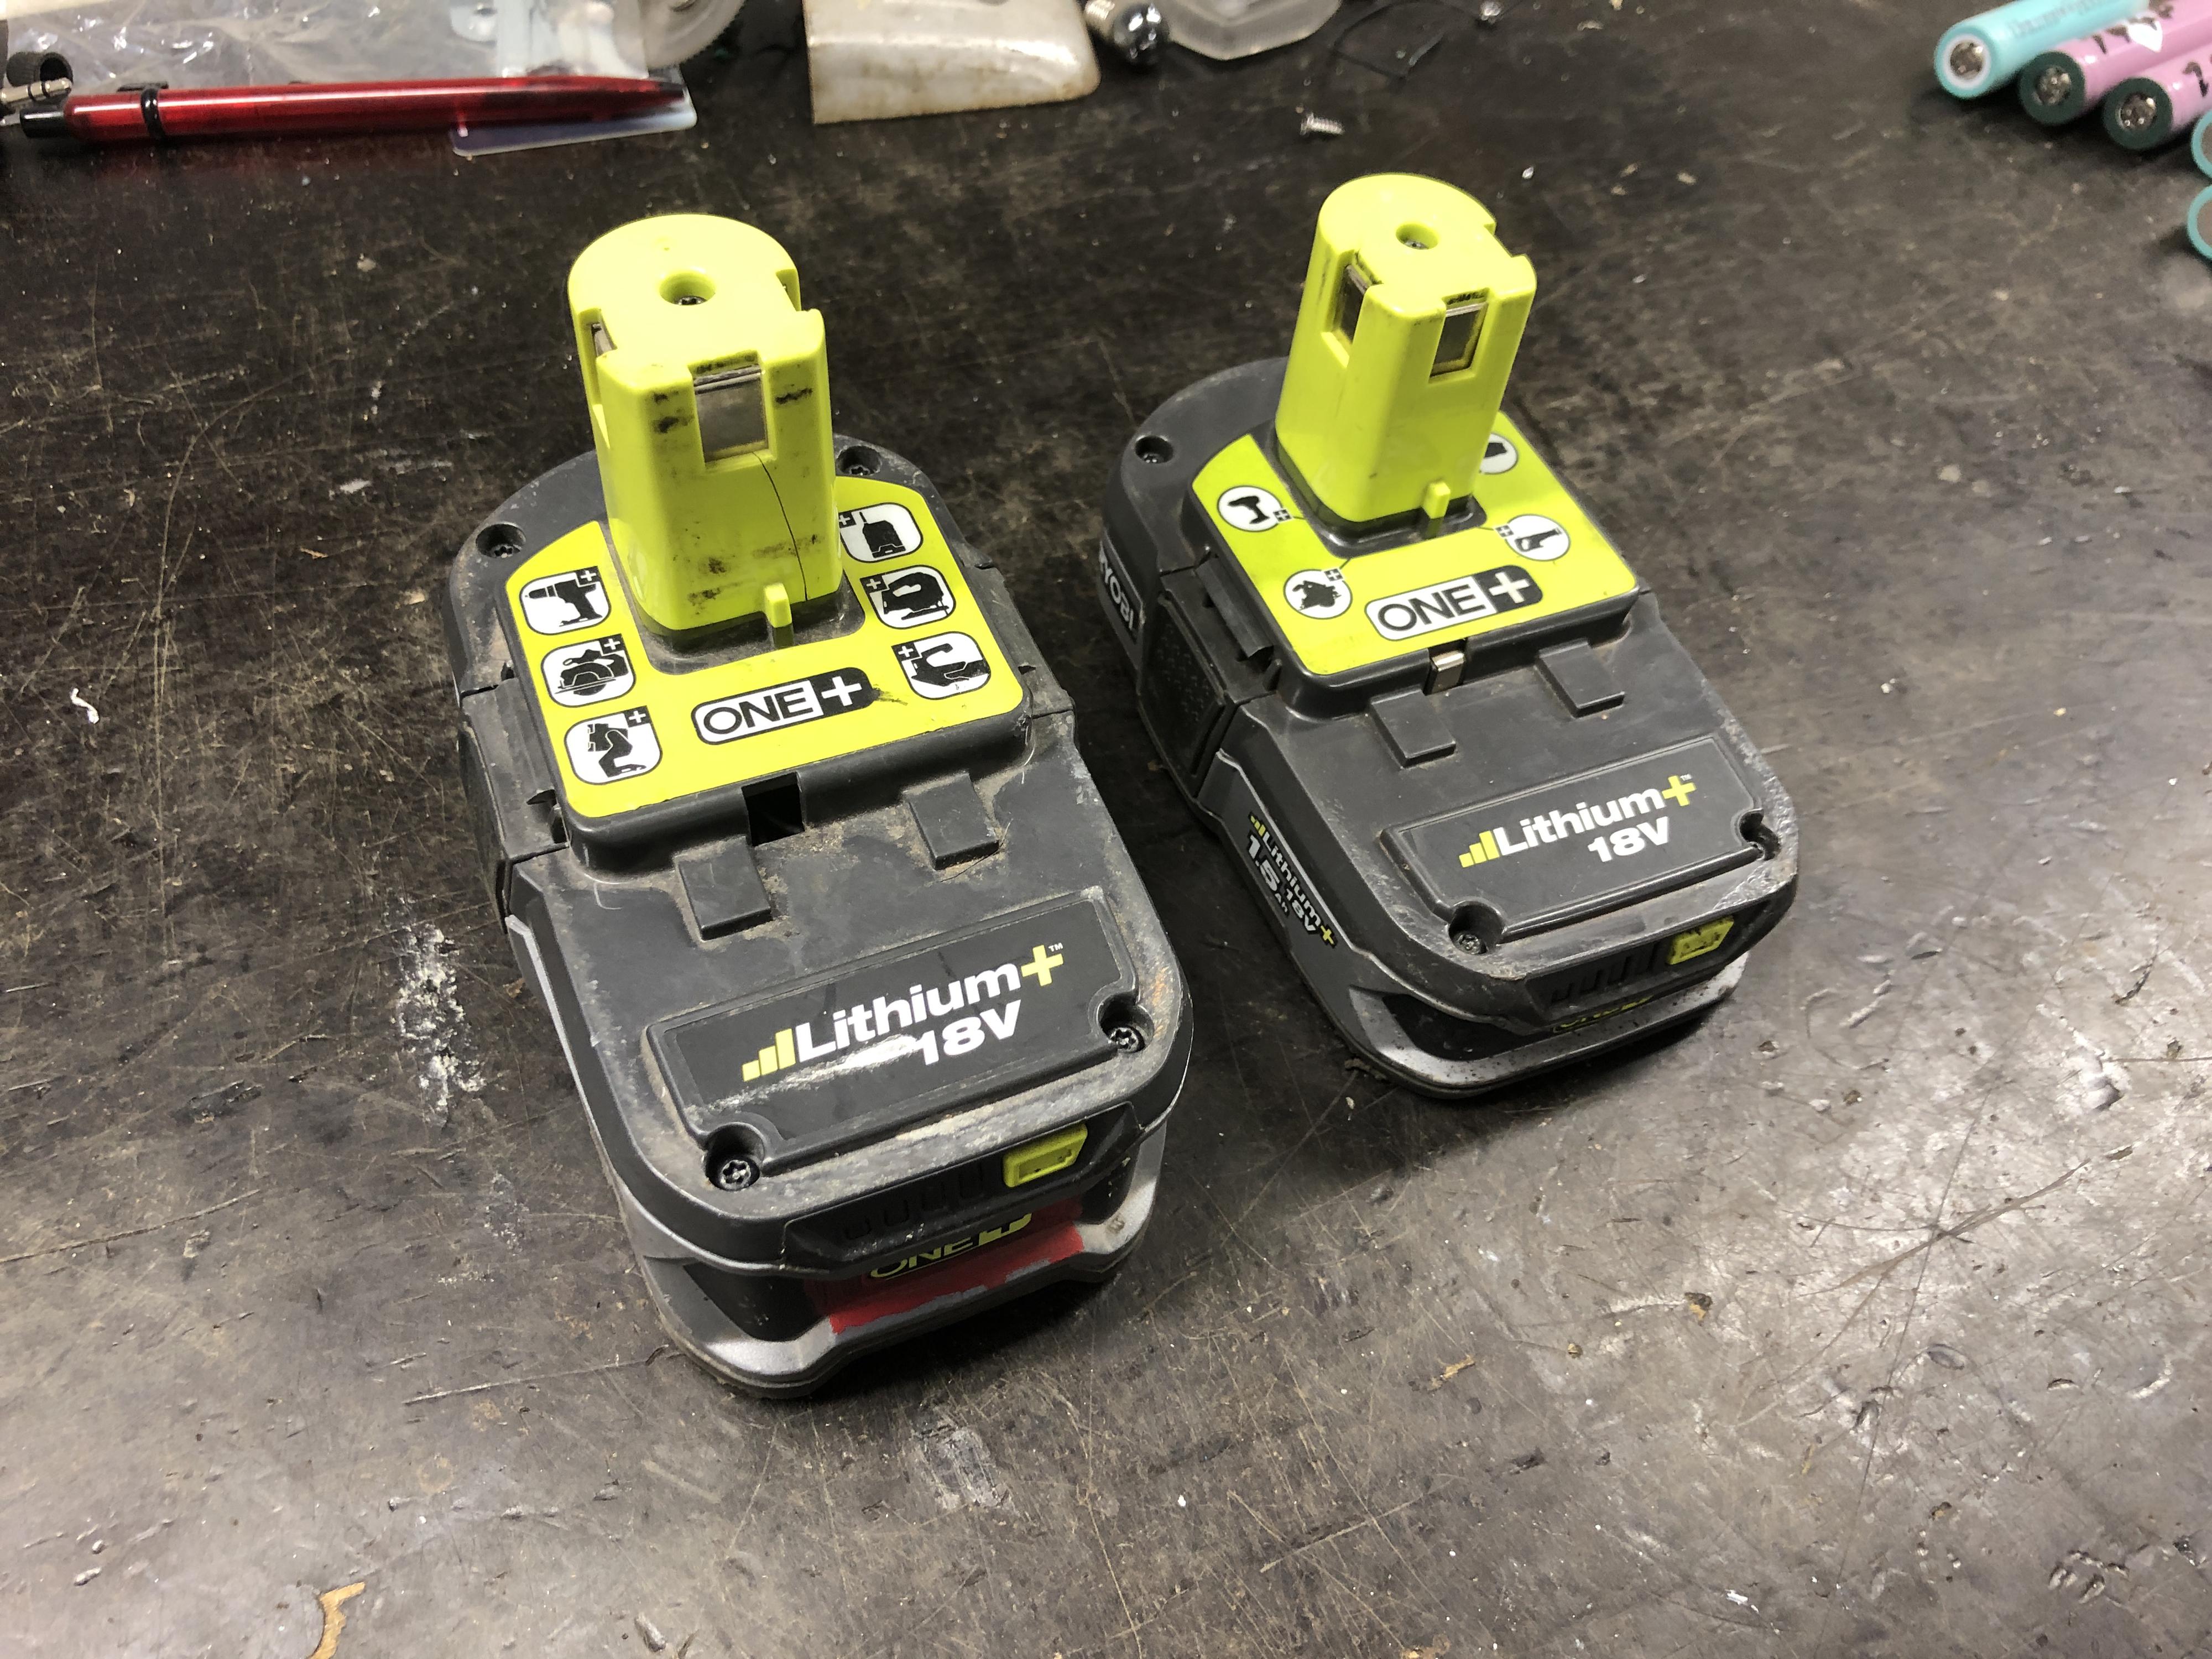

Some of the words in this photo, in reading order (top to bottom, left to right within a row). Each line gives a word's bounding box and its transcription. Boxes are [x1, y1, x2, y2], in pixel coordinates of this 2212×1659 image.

[1587, 816, 1669, 863] 18V
[1285, 888, 1316, 931] 18V
[914, 999, 1022, 1066] 18V
